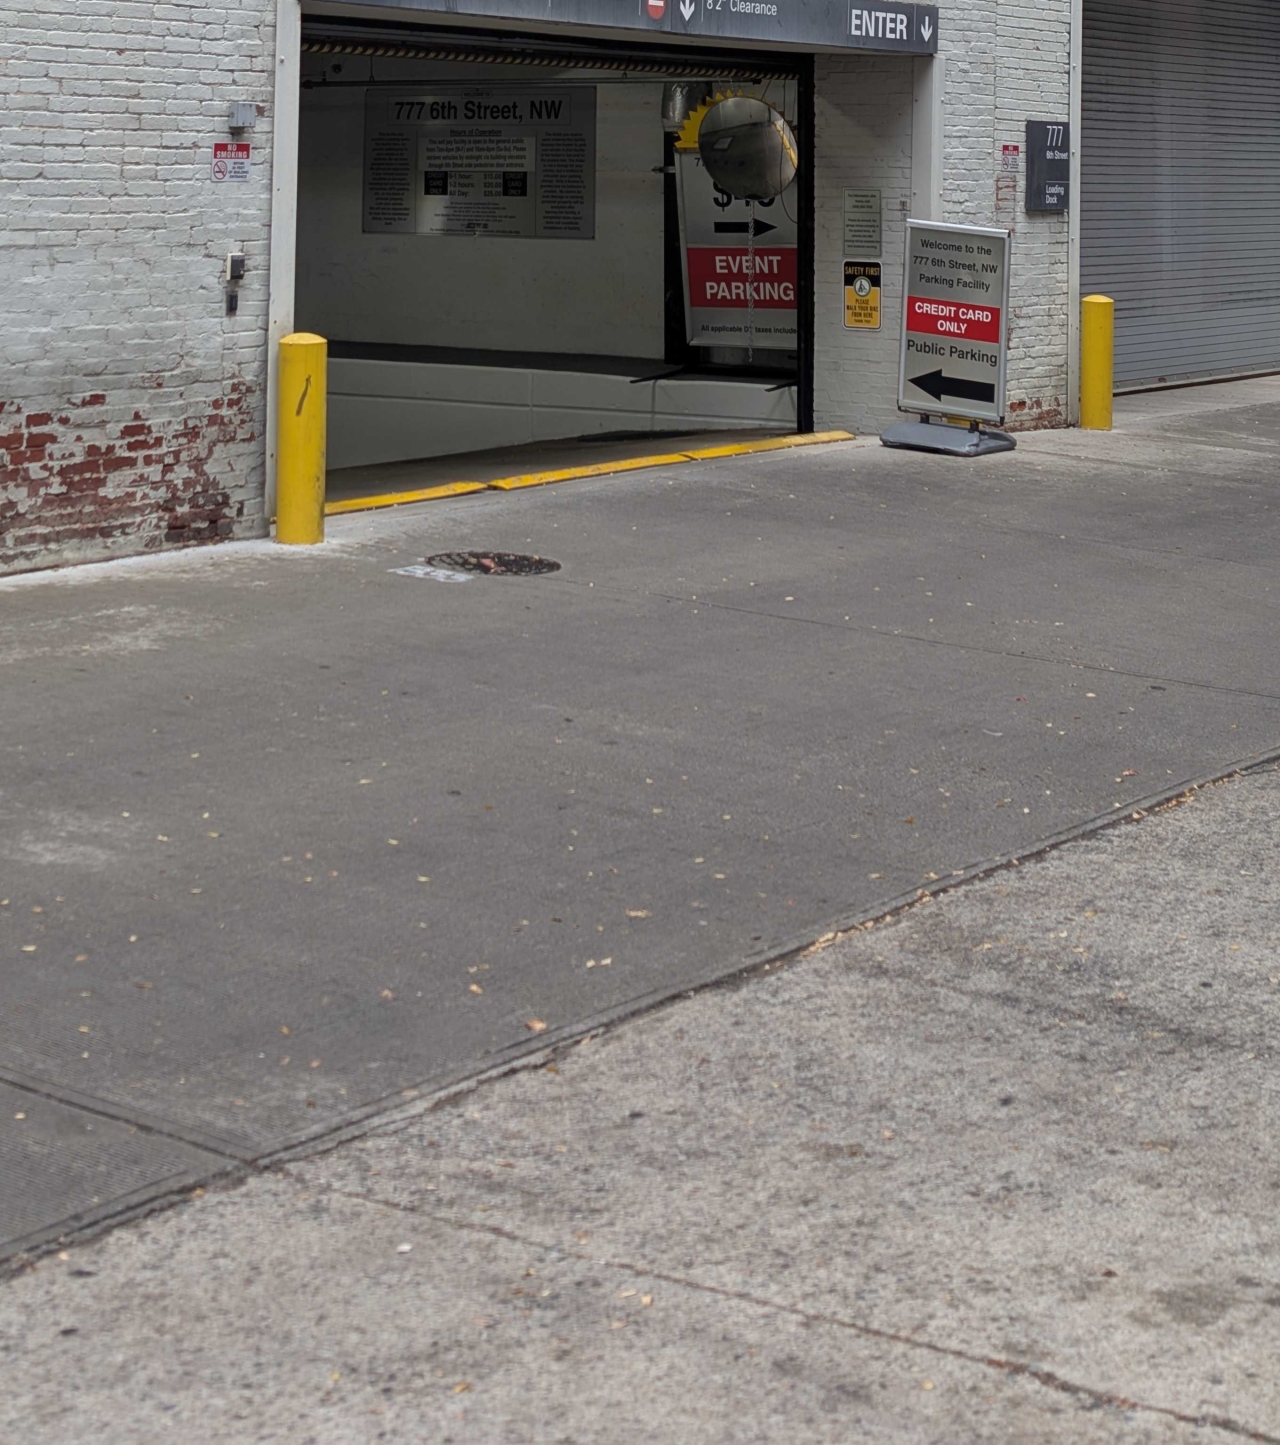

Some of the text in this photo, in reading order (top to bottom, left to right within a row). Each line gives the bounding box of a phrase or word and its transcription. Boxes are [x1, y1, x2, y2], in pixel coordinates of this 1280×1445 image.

[851, 8, 907, 40] ENTER
[394, 100, 562, 123] 777 6th Street, NW
[1046, 126, 1063, 146] 777
[1055, 150, 1068, 160] Street
[1046, 185, 1064, 195] Loading
[1046, 195, 1057, 204] Dock
[920, 239, 992, 256] Welcome to the
[715, 256, 782, 274] EVENT
[845, 266, 880, 276] SAFETY FIRST
[912, 256, 998, 274] 777 6th Street, NW
[705, 282, 794, 301] PARKING
[919, 274, 990, 292] Parking Facility
[915, 302, 992, 322] CREDIT CARD
[701, 324, 709, 332] All
[711, 325, 742, 333] applicable
[937, 320, 967, 334] ONLY
[907, 340, 997, 367] Public Parking
